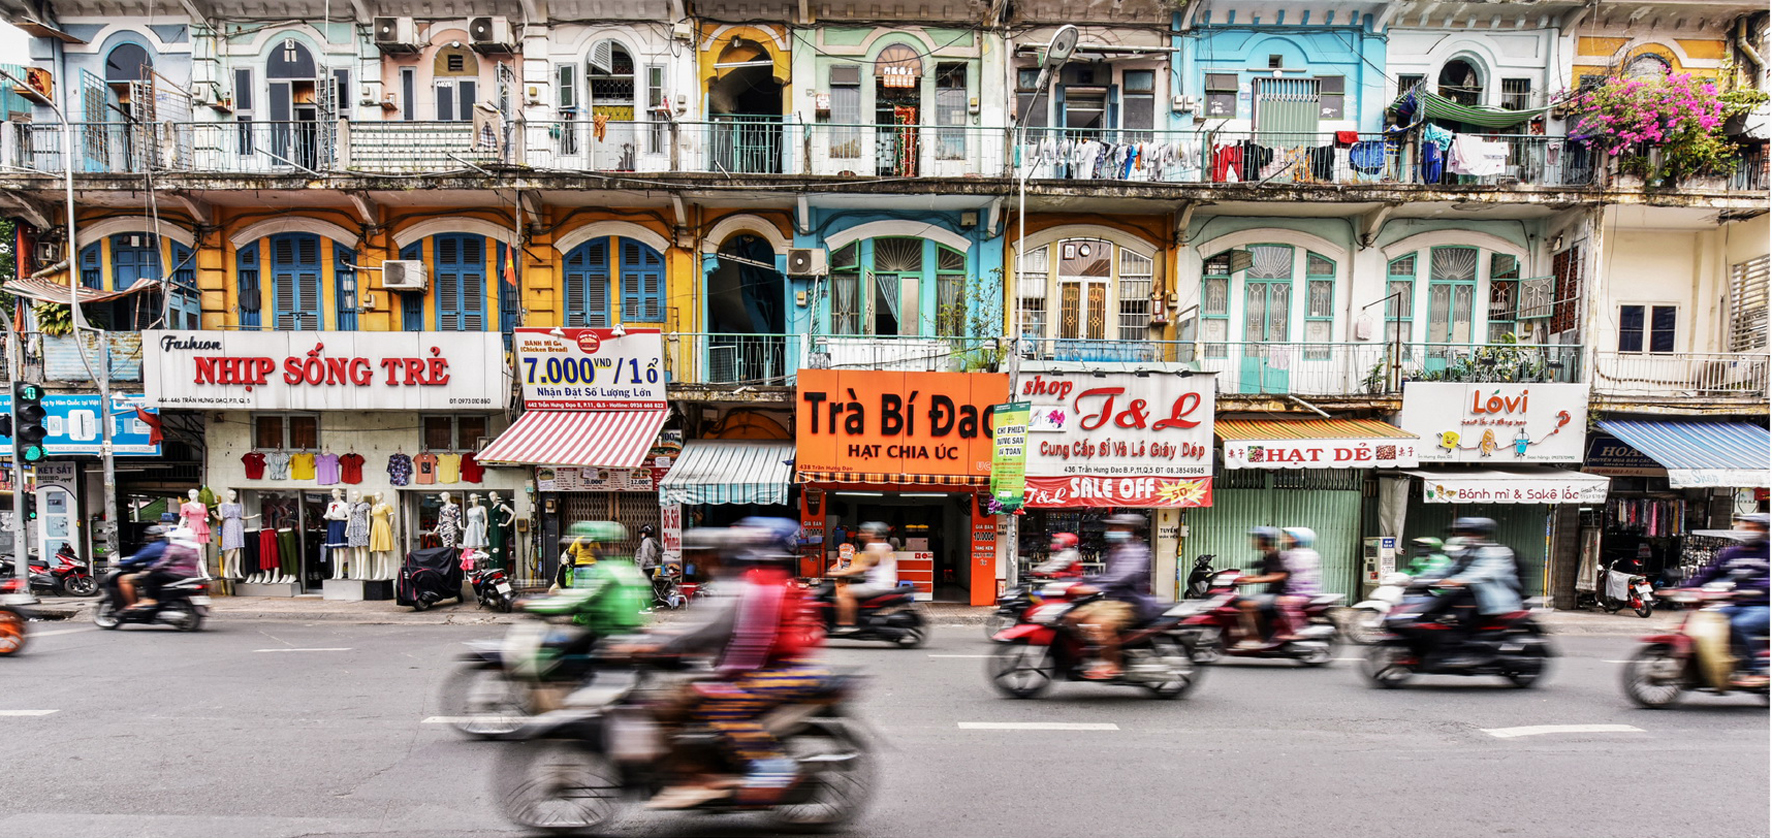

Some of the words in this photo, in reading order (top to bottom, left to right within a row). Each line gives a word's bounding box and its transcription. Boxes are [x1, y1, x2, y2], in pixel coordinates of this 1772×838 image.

[160, 335, 222, 352] Fashion
[193, 355, 276, 392] NHỊP
[283, 342, 373, 385] SỐNG
[381, 346, 451, 385] TRẺ
[22, 387, 36, 400] 0
[537, 388, 562, 398] Nhận
[564, 388, 582, 399] Đặt
[584, 387, 598, 397] Số
[600, 388, 630, 398] Lượng
[633, 388, 651, 397] Lớn
[1023, 375, 1073, 399] shop
[804, 388, 865, 434] Trà
[881, 390, 919, 436] Bí
[848, 444, 882, 460] HẠT
[887, 445, 929, 459] CHIA
[935, 443, 958, 460] ÚC
[1040, 440, 1070, 458] Cung
[1073, 438, 1096, 459] Cấp
[1182, 442, 1206, 459] Dép
[1265, 448, 1324, 465] HẠT
[1333, 442, 1372, 461] DẺ
[1069, 477, 1113, 499] SALE
[1119, 477, 1155, 499] OFF
[1458, 488, 1490, 500] Bánh
[1494, 489, 1509, 499] mì
[1513, 490, 1522, 499] &
[1526, 488, 1557, 500] Sakê
[1561, 486, 1580, 499] lắc
